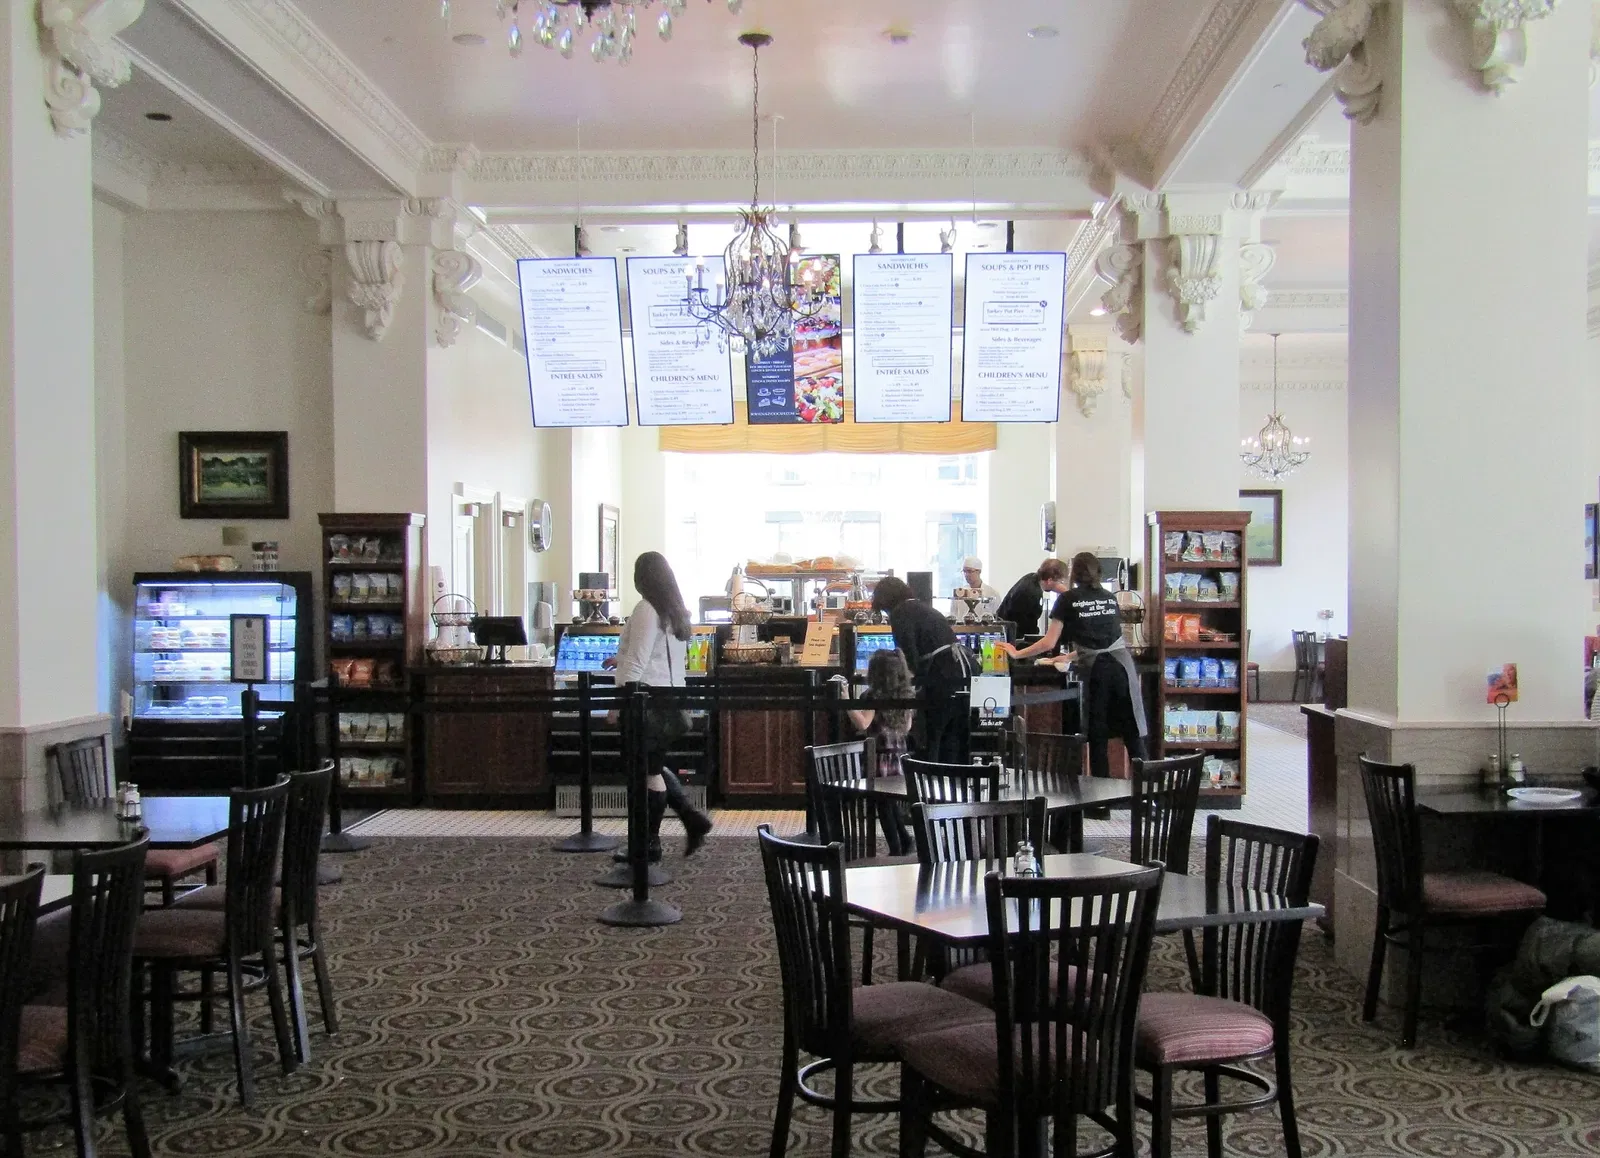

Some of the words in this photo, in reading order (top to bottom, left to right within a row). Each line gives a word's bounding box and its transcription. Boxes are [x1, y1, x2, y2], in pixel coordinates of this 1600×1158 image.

[877, 262, 929, 270] SANDWICHES
[541, 267, 593, 275] SANDWICHES
[550, 372, 576, 380] ENTRÉE
[577, 372, 604, 380] SALADS
[978, 371, 1023, 379] CHILDREN'S
[1025, 371, 1048, 379] MENU
[1078, 610, 1101, 618] Nauvoo
